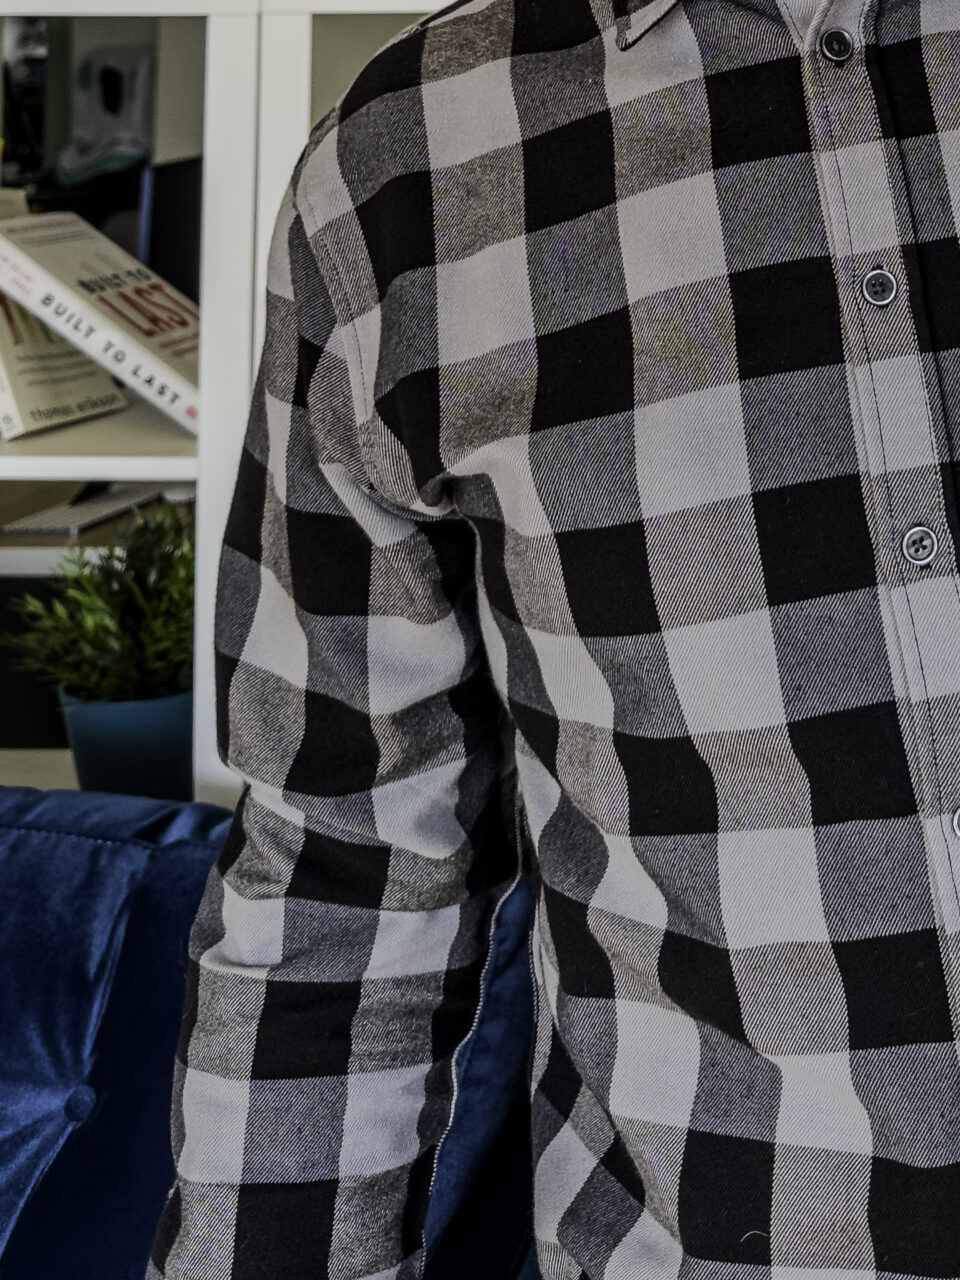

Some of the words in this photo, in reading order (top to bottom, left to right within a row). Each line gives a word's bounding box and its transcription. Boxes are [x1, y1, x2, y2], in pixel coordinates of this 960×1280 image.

[41, 292, 97, 339] BUILT
[102, 341, 126, 364] TO
[132, 366, 182, 406] LAST
